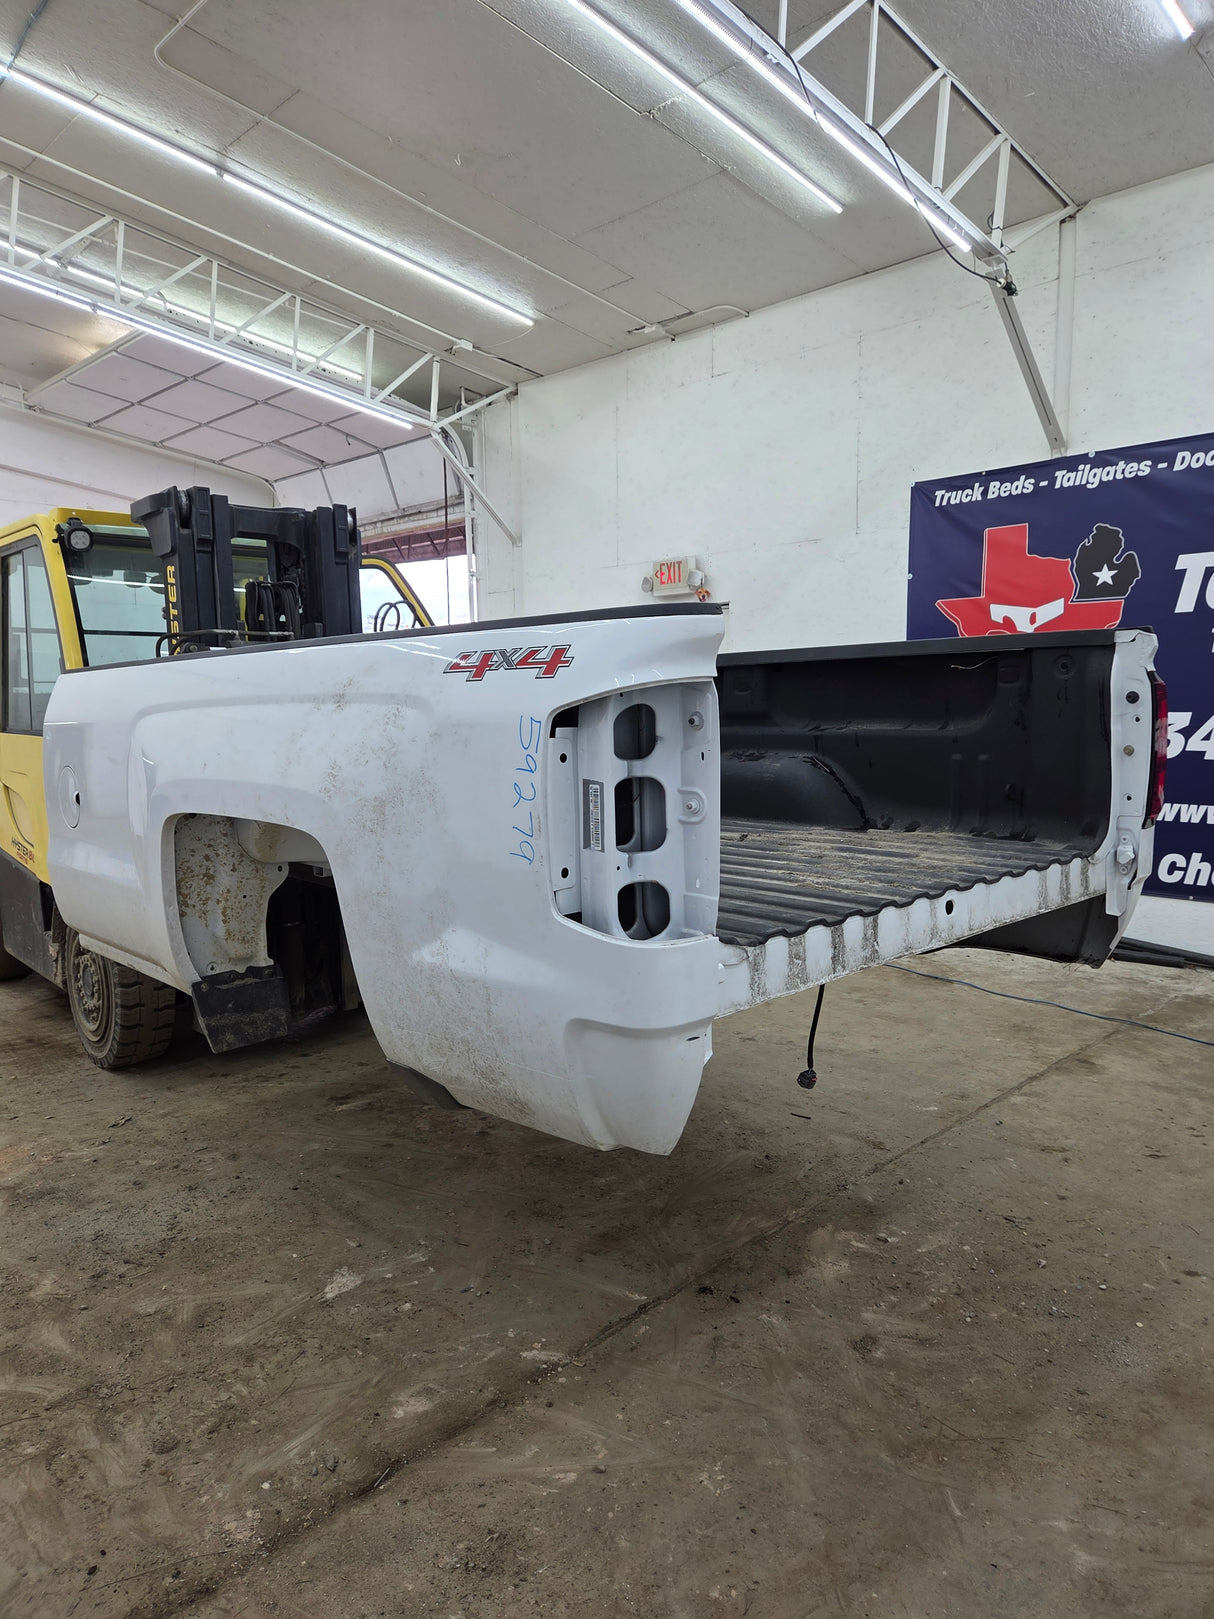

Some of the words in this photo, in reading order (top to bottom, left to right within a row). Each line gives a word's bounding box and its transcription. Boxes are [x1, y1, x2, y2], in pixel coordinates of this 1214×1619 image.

[934, 482, 985, 507] Truck
[987, 475, 1035, 500] Beds
[1054, 460, 1152, 489] Tailgates
[660, 560, 682, 585] EXIT
[1174, 551, 1214, 613] T
[510, 715, 542, 865] 59279
[1157, 852, 1214, 886] Ch
